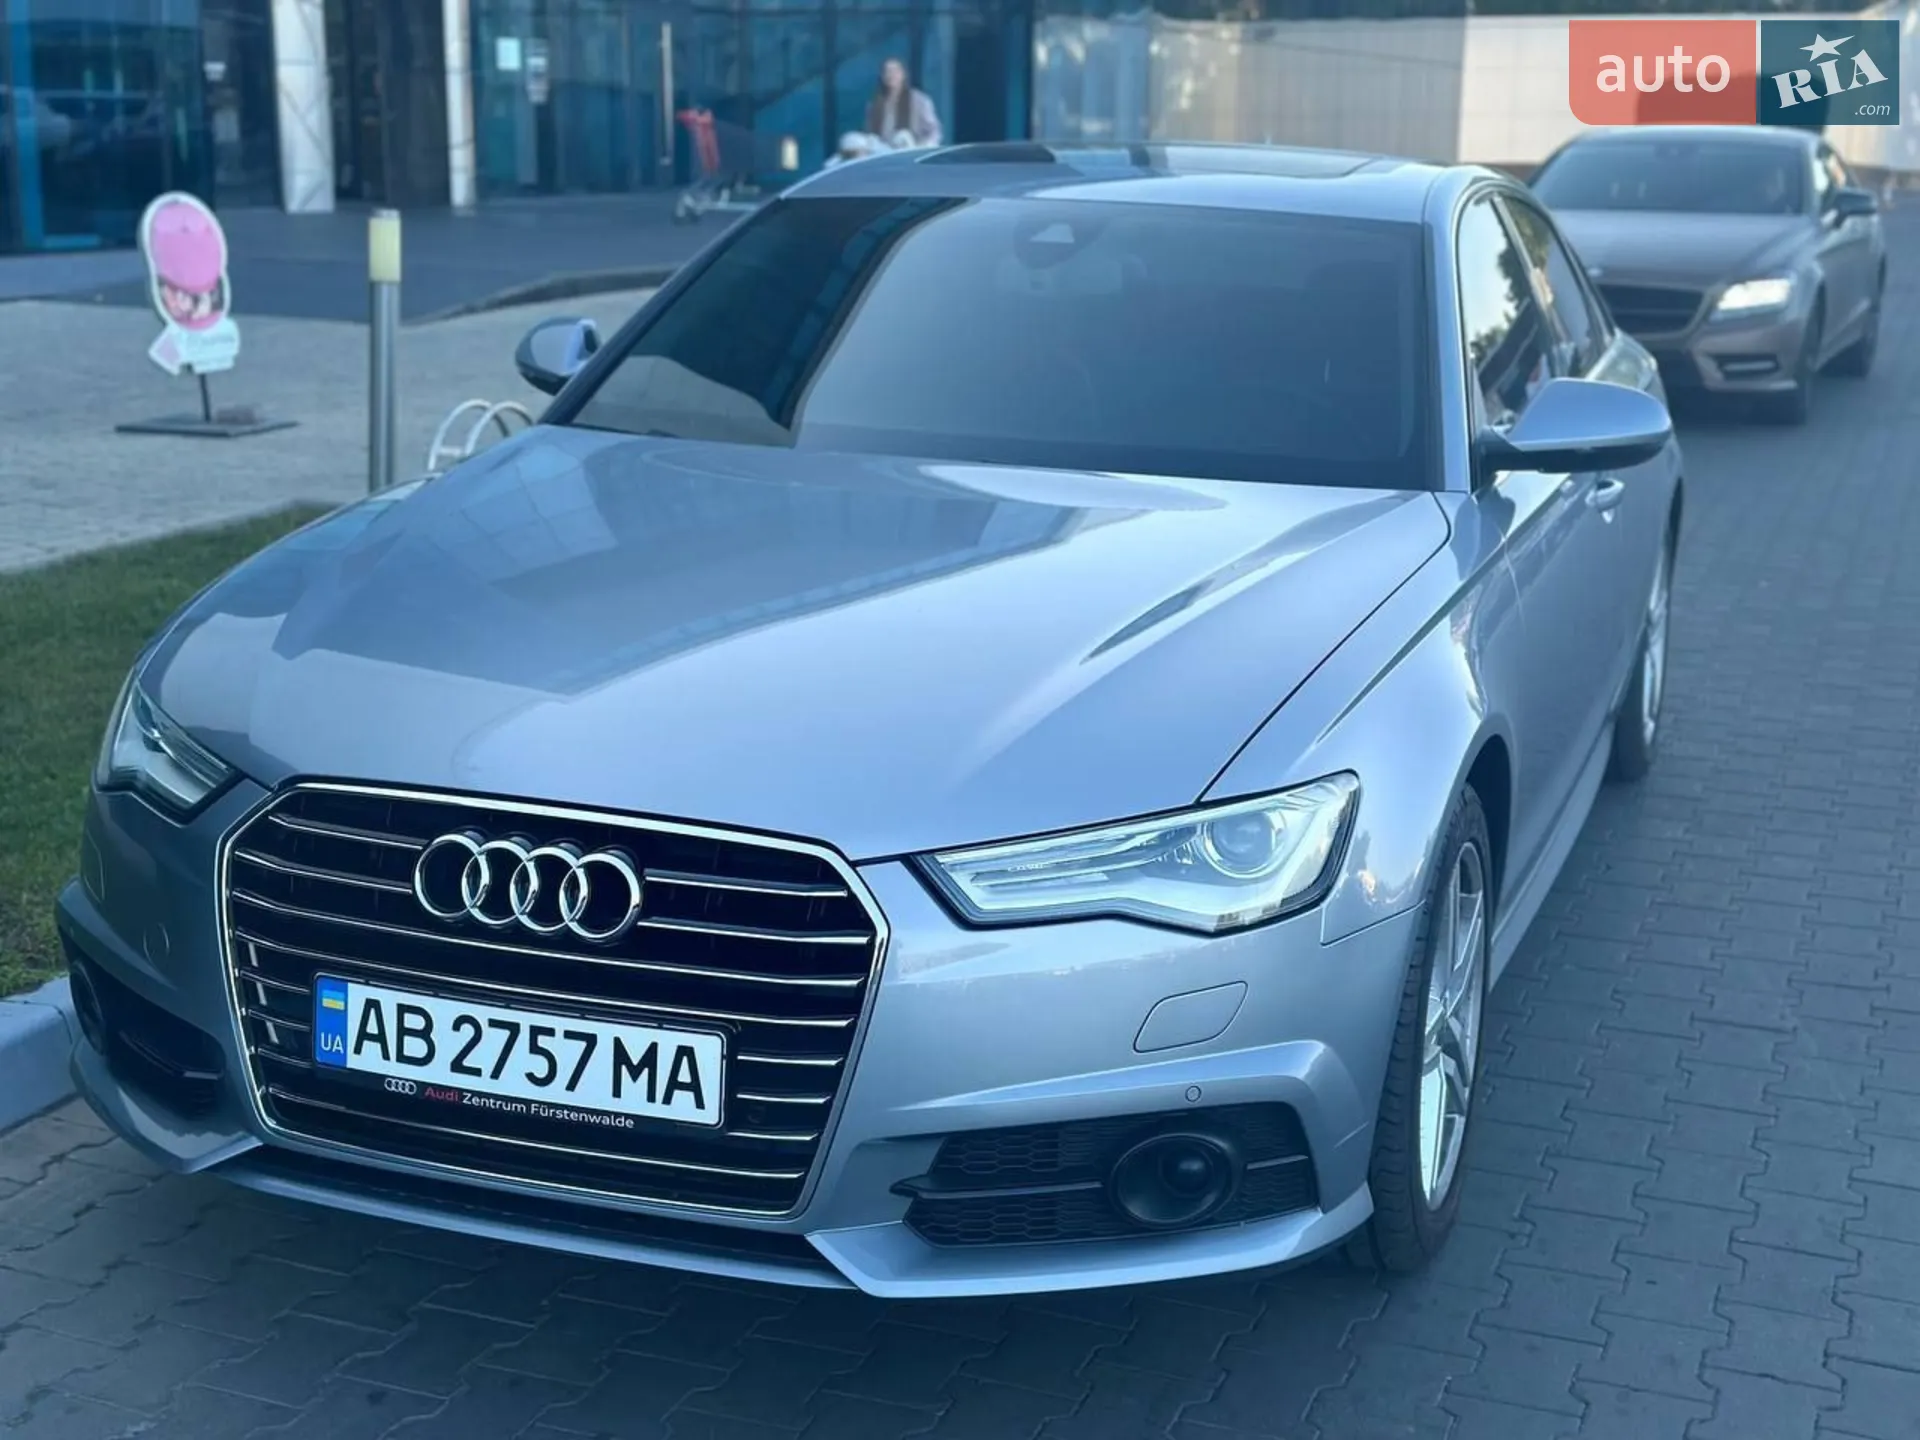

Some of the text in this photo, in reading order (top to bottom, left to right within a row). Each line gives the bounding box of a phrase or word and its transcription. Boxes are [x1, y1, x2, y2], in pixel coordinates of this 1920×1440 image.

[320, 1031, 344, 1055] UA
[353, 997, 706, 1110] AB 2757 MA
[423, 1085, 635, 1129] Audi Zentrum Fürstenwalde
